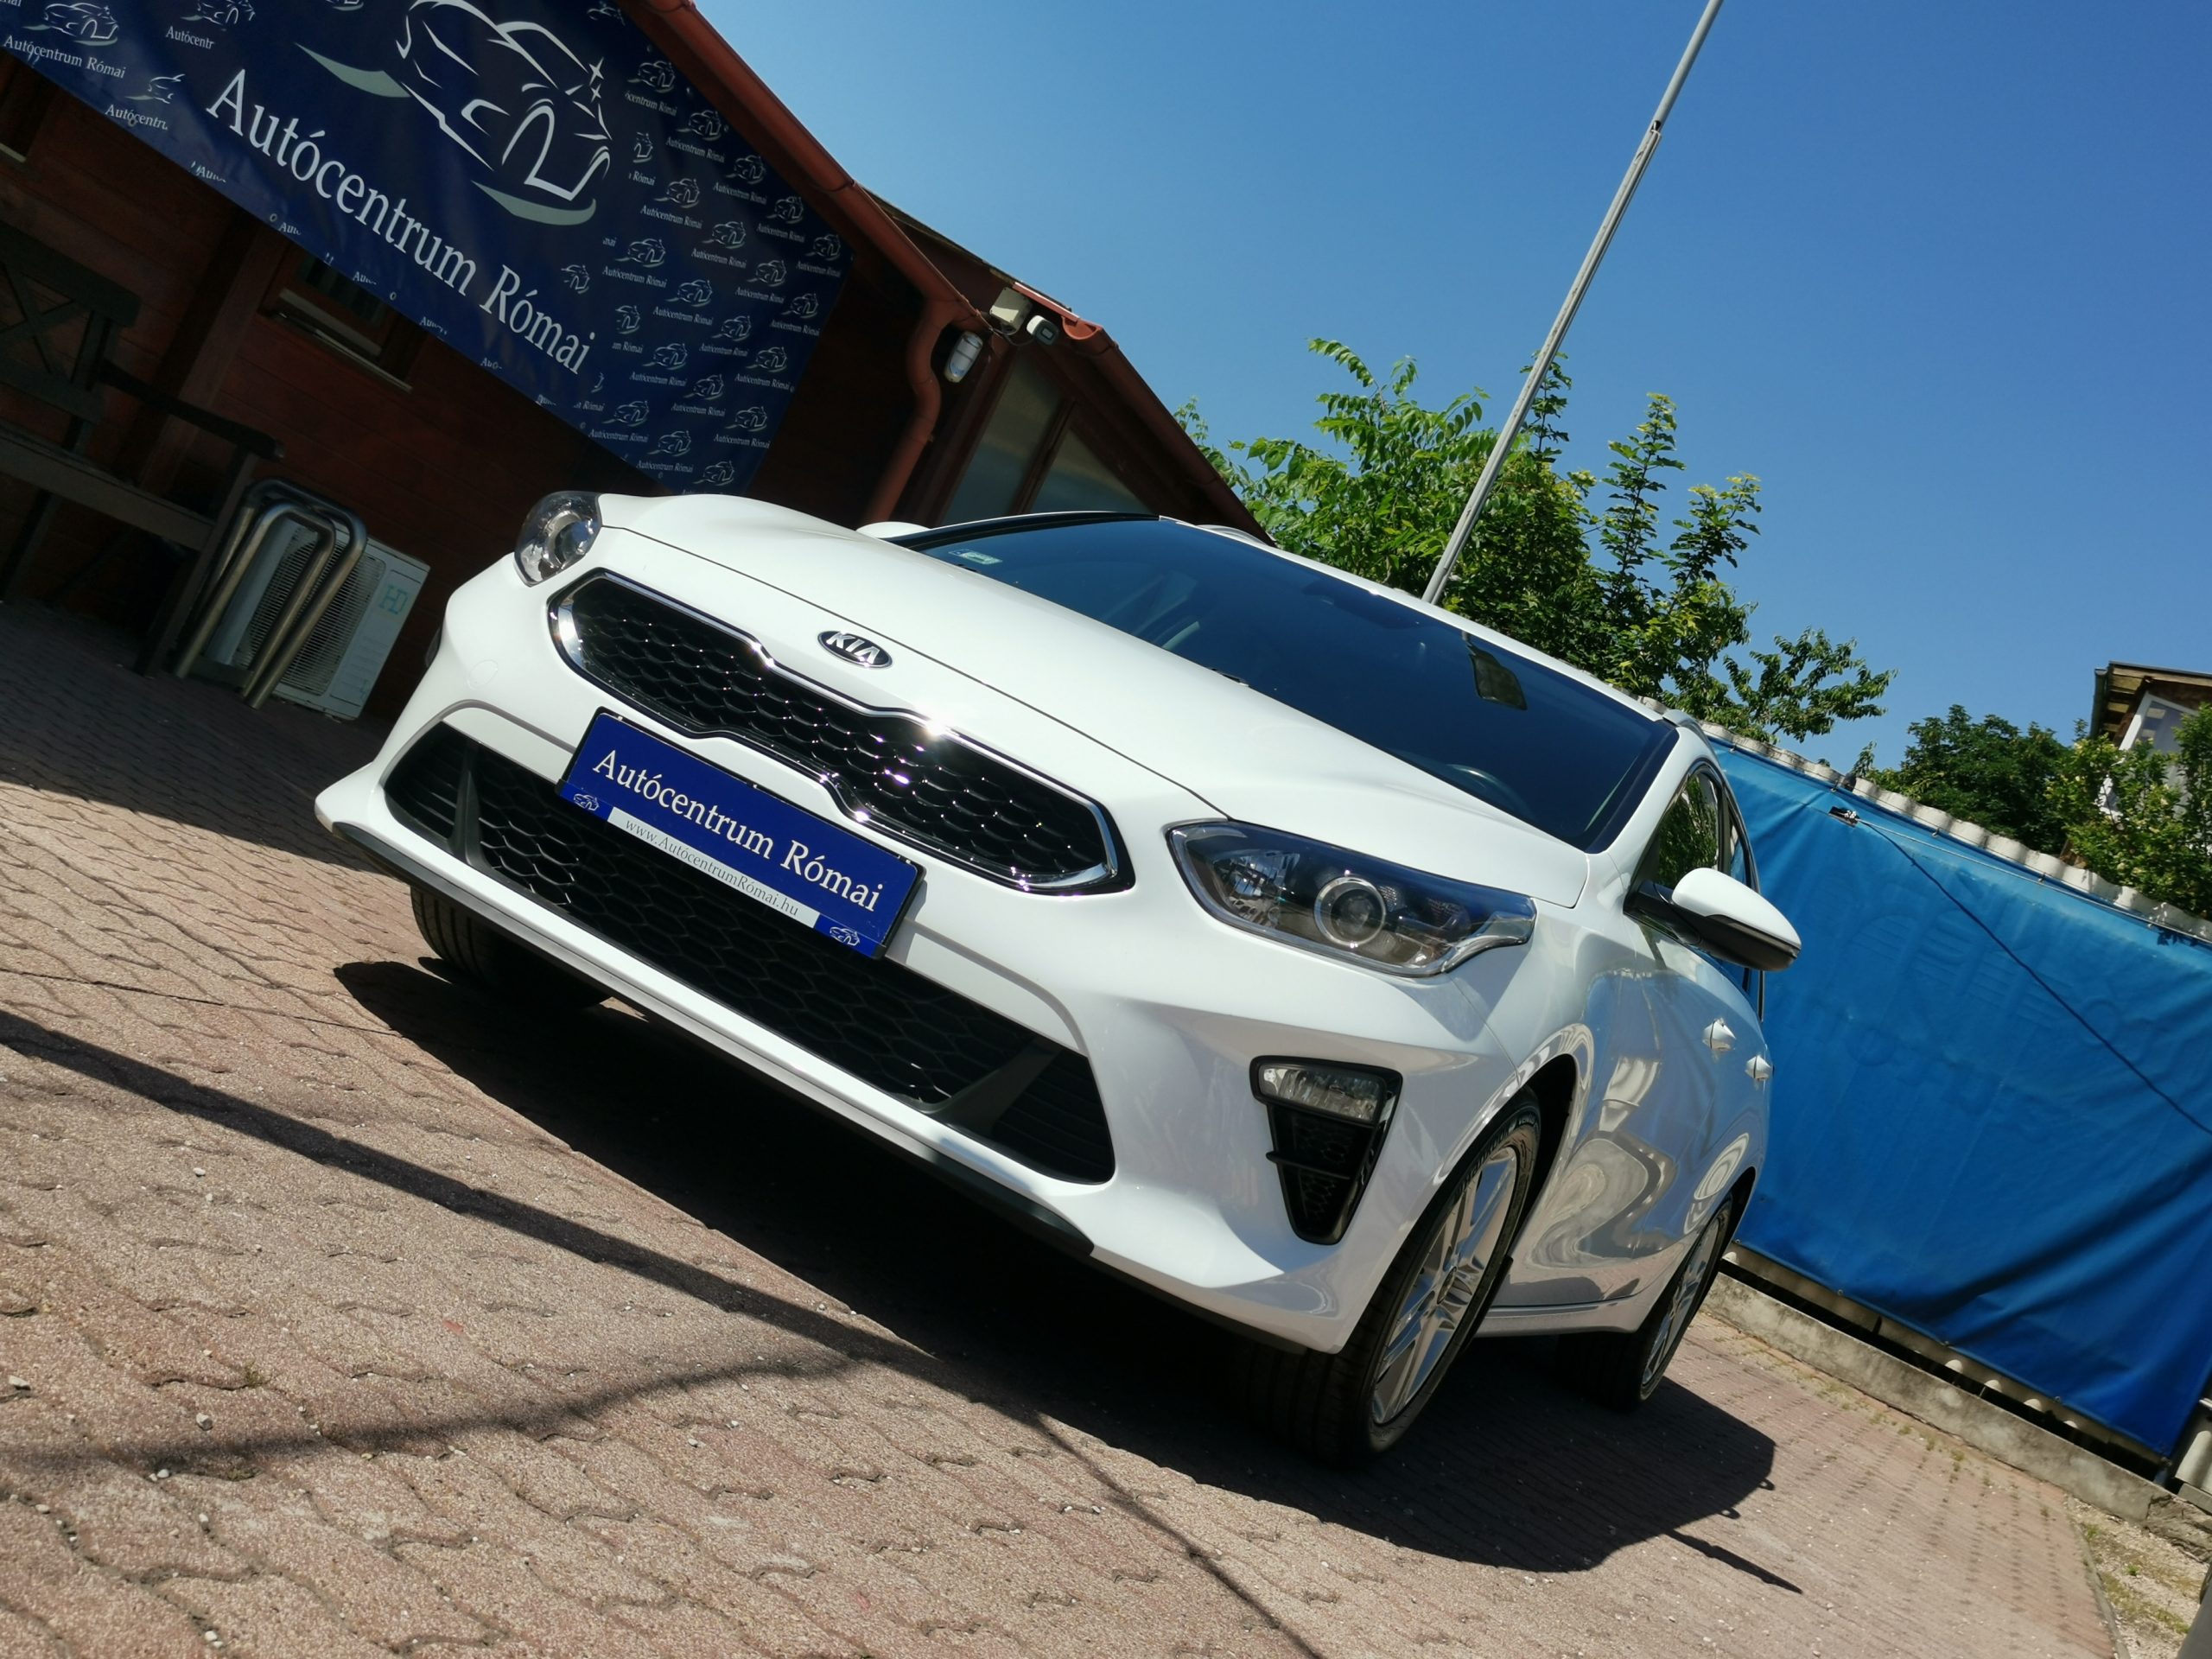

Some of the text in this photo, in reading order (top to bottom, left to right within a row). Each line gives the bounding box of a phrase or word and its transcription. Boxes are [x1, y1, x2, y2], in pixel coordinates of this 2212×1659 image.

[3, 35, 126, 79] Autócentrum Római
[206, 68, 595, 375] Autócentrum Római
[826, 632, 880, 664] KIA
[592, 749, 884, 912] Autócentrum Római
[626, 820, 798, 916] www.AutócentrumRómai.hu
